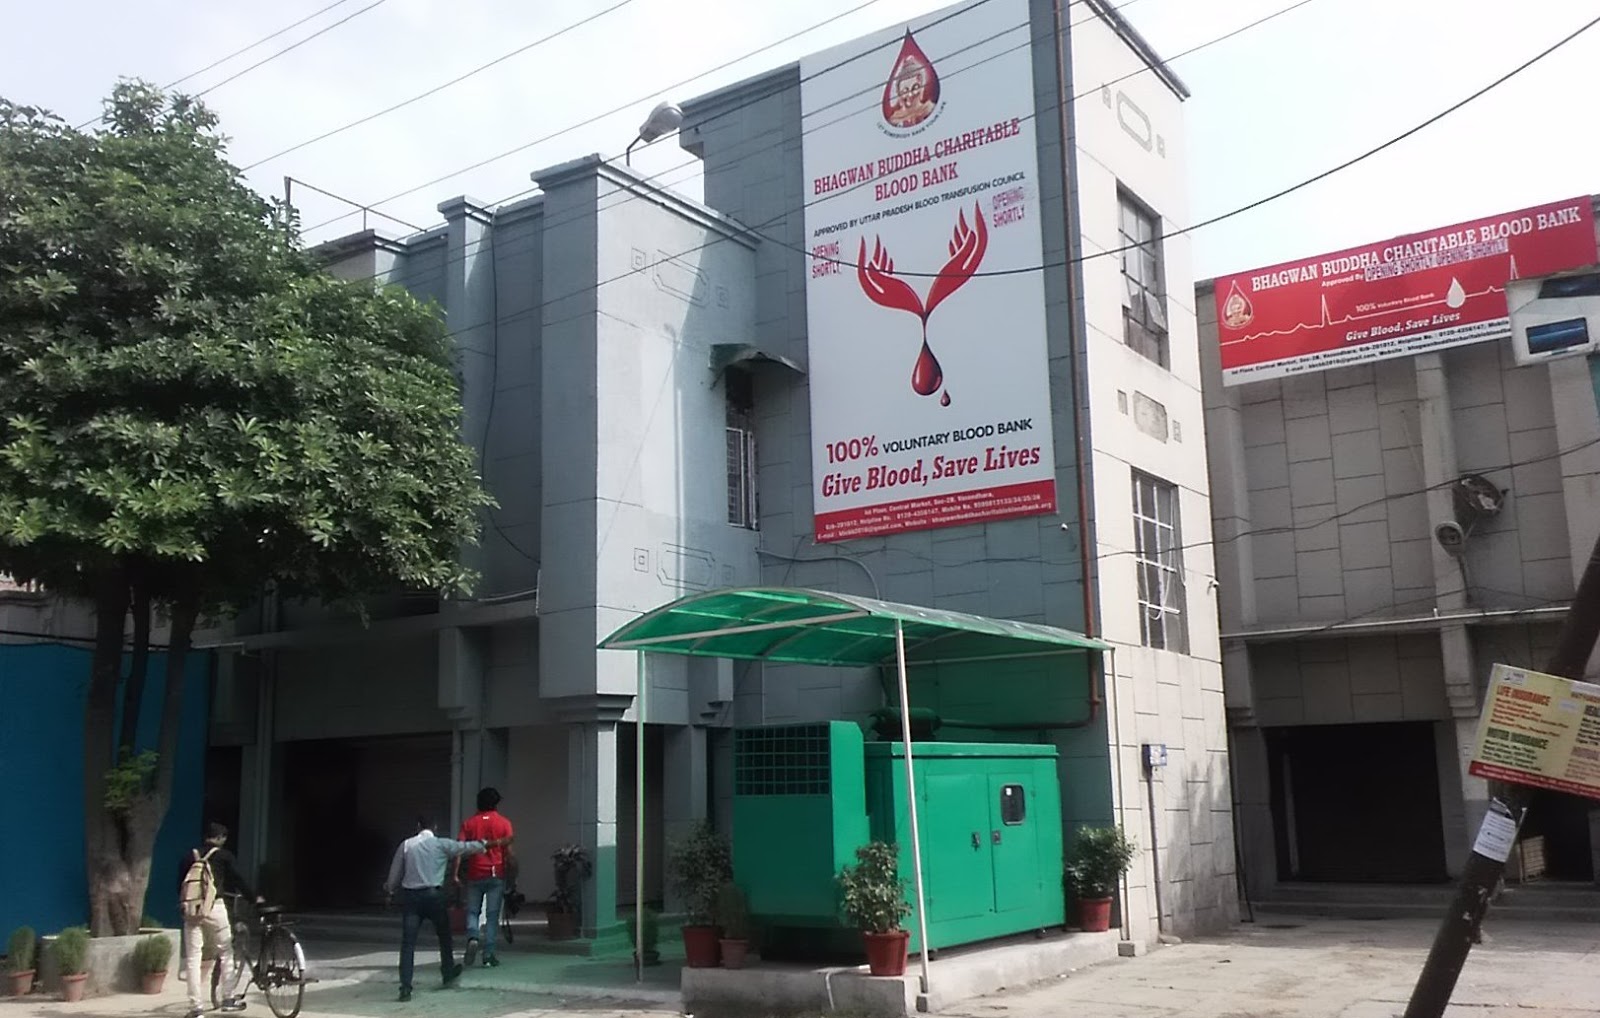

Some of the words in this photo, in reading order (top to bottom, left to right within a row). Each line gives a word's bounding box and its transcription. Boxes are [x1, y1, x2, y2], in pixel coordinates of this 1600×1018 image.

[813, 162, 874, 195] BHAGWAN
[878, 146, 931, 178] BUDDHA
[934, 117, 1021, 158] CHARITABLE
[875, 173, 918, 201] BLOOD
[922, 162, 959, 187] BANK
[813, 222, 848, 237] APPROVED
[849, 219, 858, 228] BY
[859, 212, 881, 225] UTTAR
[881, 203, 913, 219] PRADESH
[914, 196, 940, 210] BLOOD
[941, 181, 991, 202] TRANSFUSION
[991, 171, 1025, 188] COUNCIL
[993, 204, 1025, 228] SHORTLY
[1251, 263, 1319, 292] BHAGWAN
[1321, 250, 1379, 277] BUDDHA
[1383, 228, 1477, 263] CHARITABLE
[1480, 217, 1533, 242] BLOOD
[1537, 206, 1581, 230] BANK
[1321, 275, 1354, 288] Approved
[1345, 330, 1368, 341] Give
[1370, 322, 1405, 337] Blood,
[1405, 317, 1430, 331] Save
[1432, 311, 1461, 325] Lives
[1355, 303, 1376, 312] 100%
[825, 435, 879, 464] 100%
[882, 432, 950, 453] VOLUNTARY
[952, 424, 994, 442] BLOOD
[997, 418, 1033, 434] BANK
[821, 471, 862, 498] Give
[866, 459, 929, 490] Blood,
[932, 455, 978, 480] Save
[982, 445, 1041, 472] Lives
